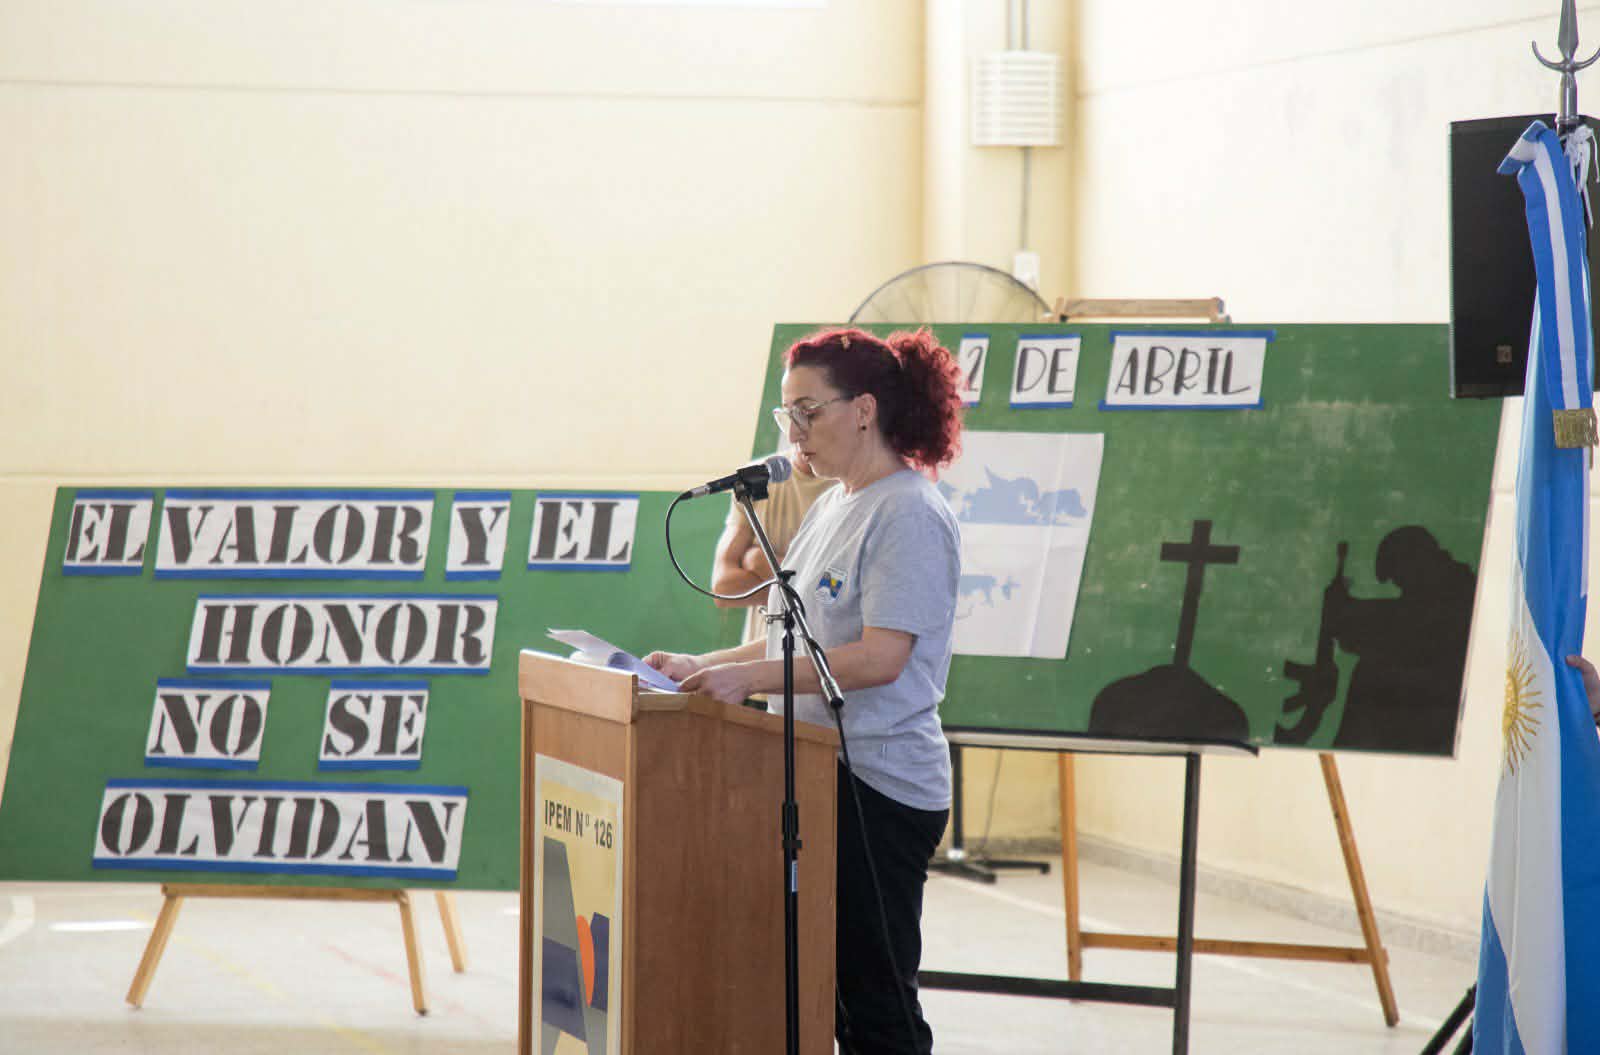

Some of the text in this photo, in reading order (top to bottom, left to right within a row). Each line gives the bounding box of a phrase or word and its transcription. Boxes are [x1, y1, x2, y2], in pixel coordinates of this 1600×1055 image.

[963, 345, 1252, 396] 2 DE ABRIL
[66, 501, 630, 565] EL VALOR Y EL
[193, 603, 487, 666] HONOR
[148, 693, 425, 756] NO SE
[100, 792, 459, 863] OLVIDAN
[544, 799, 572, 833] IPEM
[593, 820, 613, 849] 126
